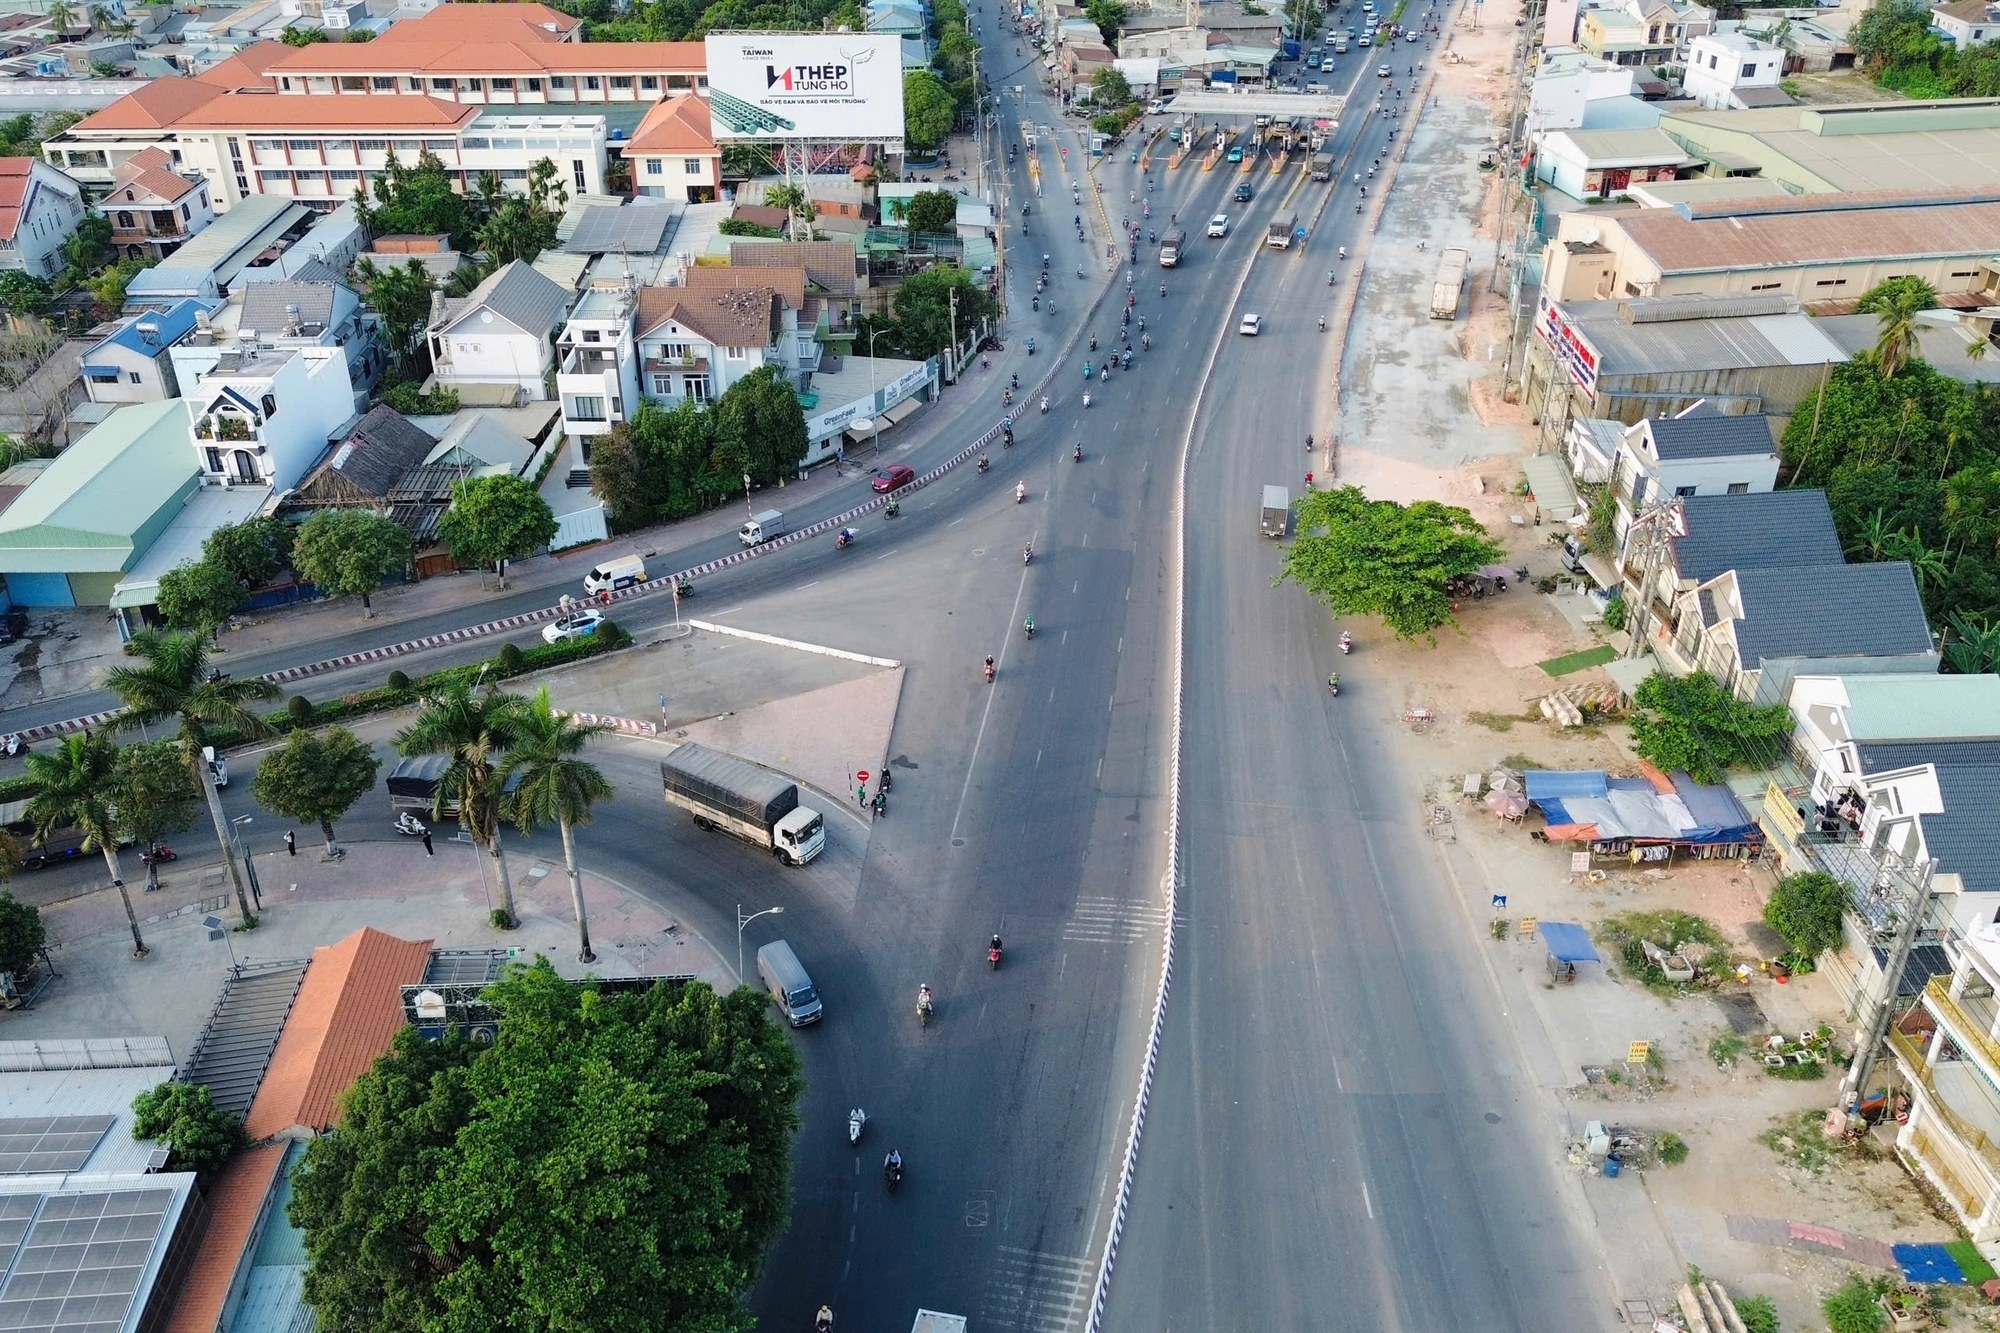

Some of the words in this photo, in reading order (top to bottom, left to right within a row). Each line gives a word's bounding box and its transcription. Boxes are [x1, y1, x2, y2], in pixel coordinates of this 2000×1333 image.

[795, 62, 847, 79] THÉP
[794, 81, 827, 90] TUNG
[831, 80, 848, 90] HO
[824, 406, 856, 426] GreenFeed
